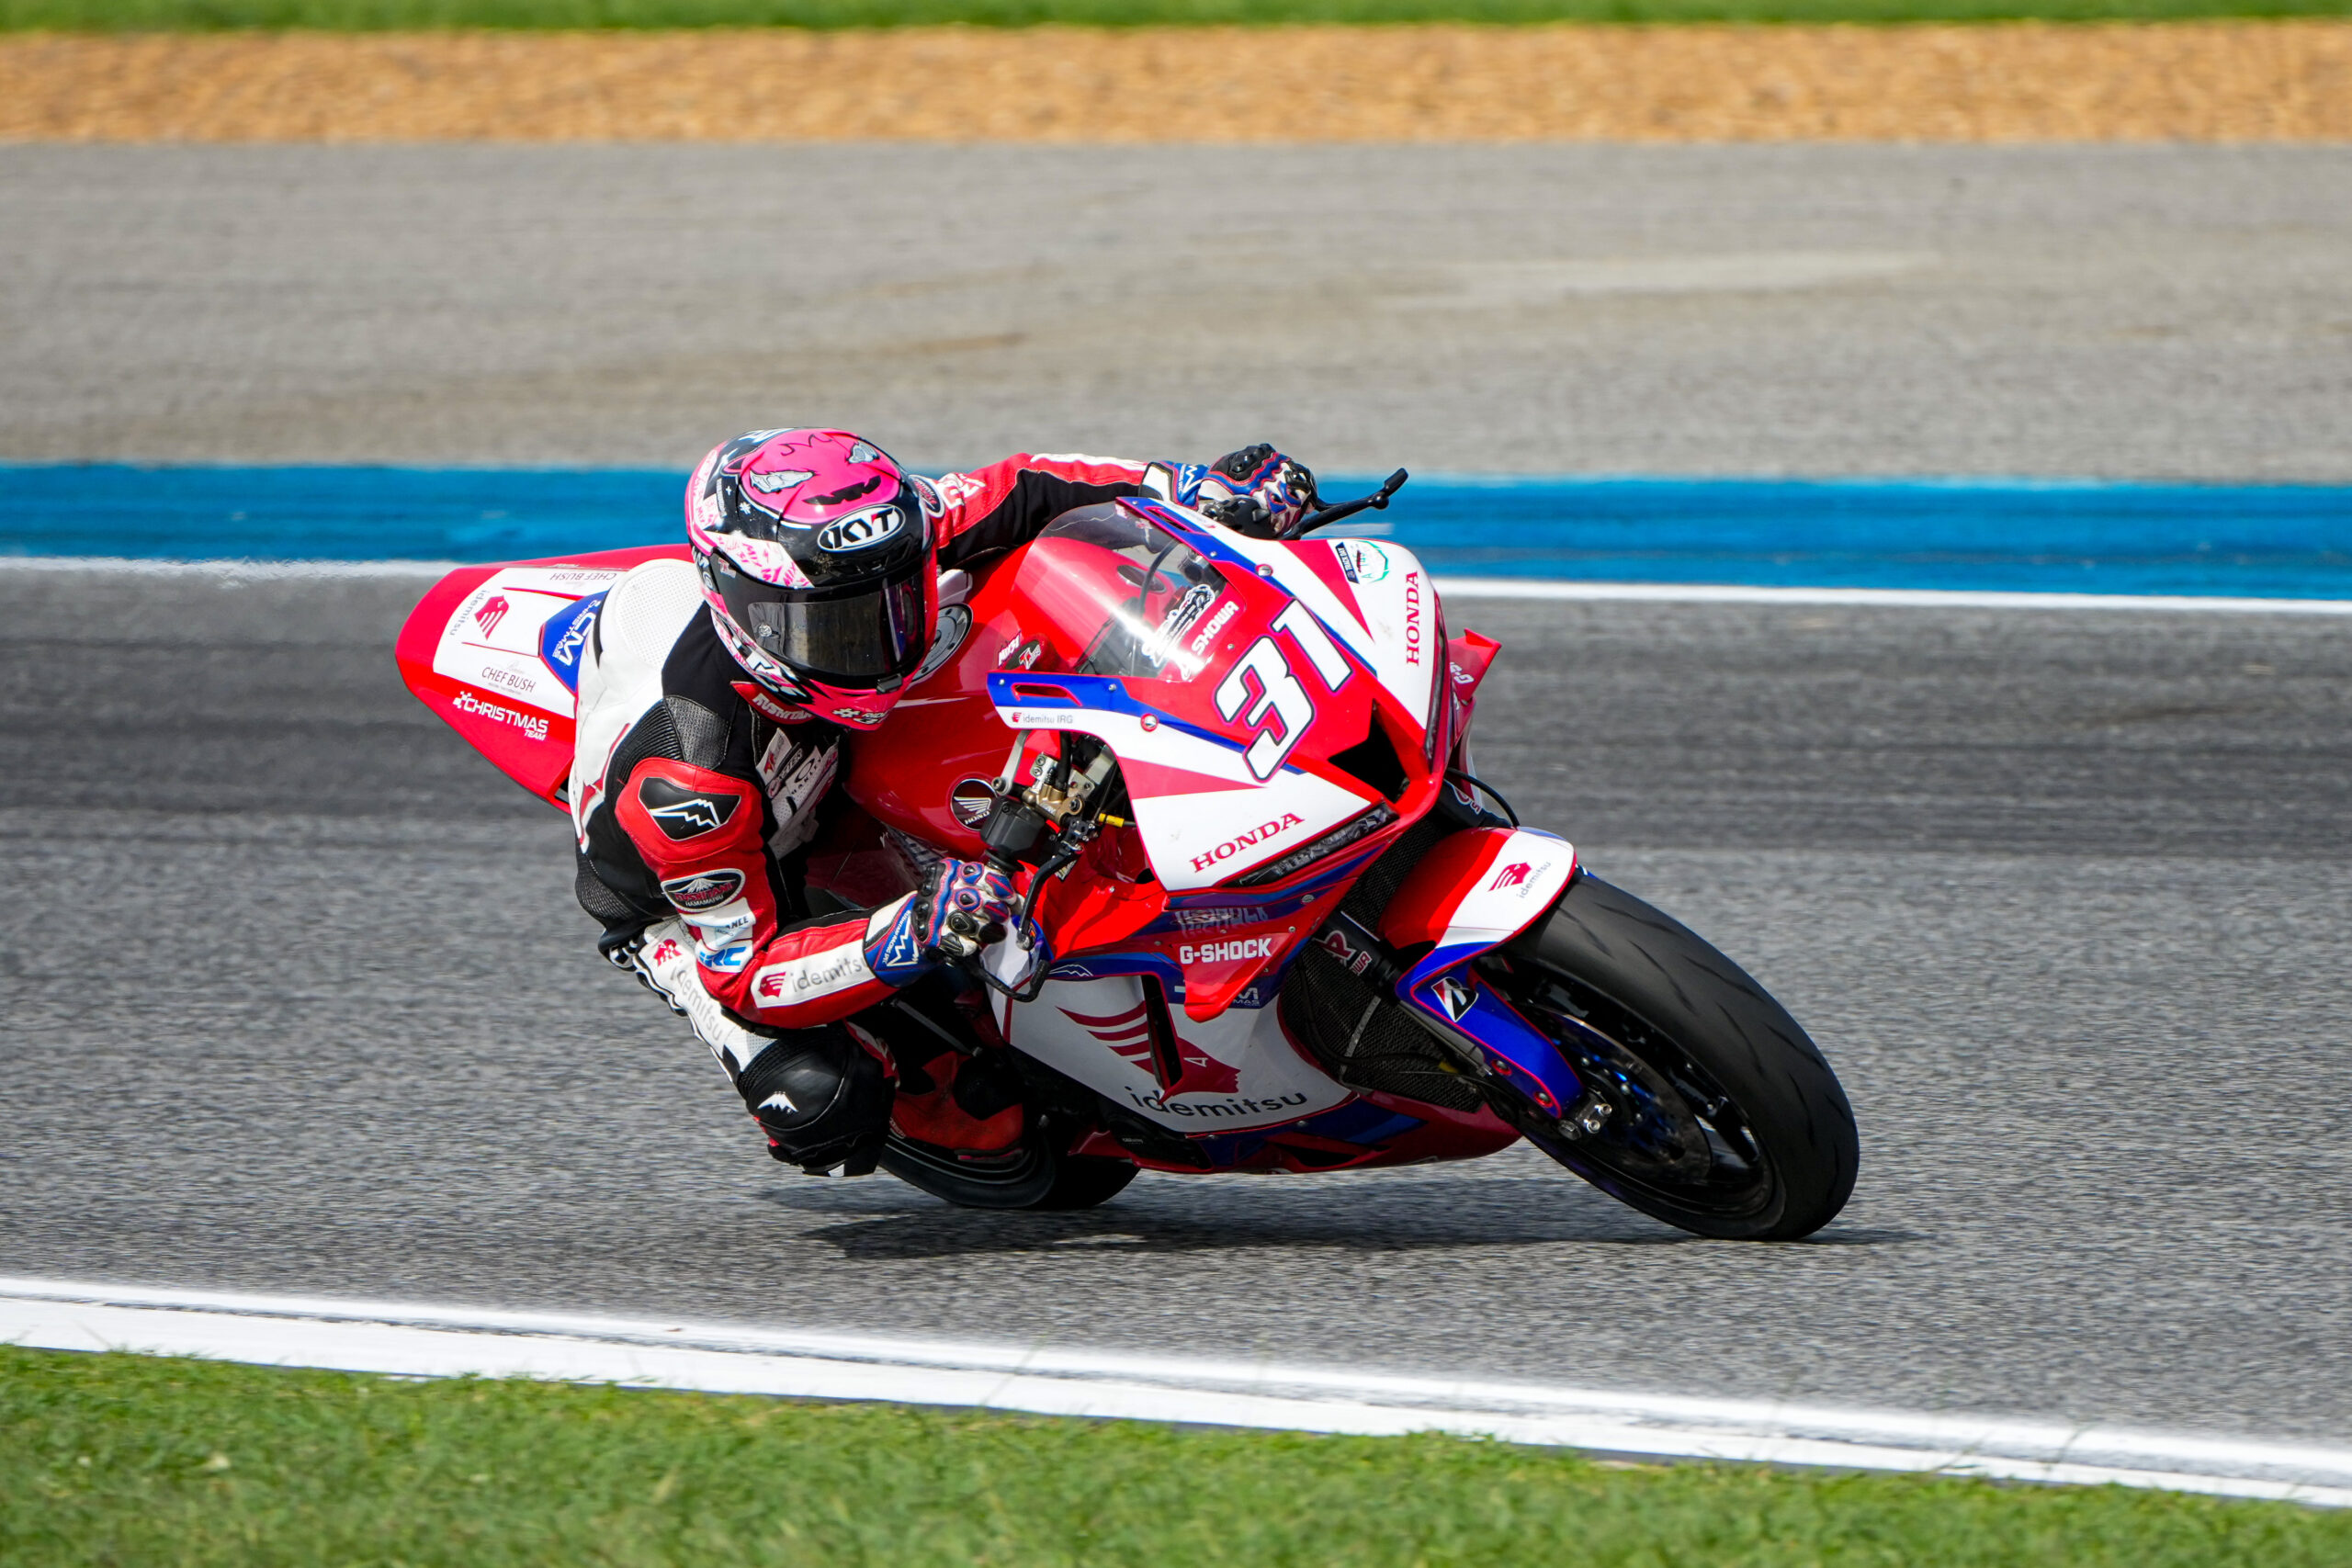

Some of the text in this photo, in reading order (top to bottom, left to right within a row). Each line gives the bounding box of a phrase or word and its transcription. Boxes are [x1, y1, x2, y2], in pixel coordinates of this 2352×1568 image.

[829, 509, 896, 549] KYT
[549, 572, 617, 581] CHEF BUSH
[449, 590, 490, 636] idemitsu
[1191, 601, 1239, 656] SHOWA
[1406, 570, 1419, 666] HONDA
[481, 667, 508, 682] CHEF
[507, 674, 537, 693] BUSH
[1213, 597, 1352, 783] 31
[462, 696, 549, 734] CHRISTMAS
[752, 693, 811, 720] KUSHITAN
[1023, 714, 1074, 725] idemitsu IRG
[525, 728, 547, 740] TEAM
[965, 808, 991, 825] HOND
[1190, 812, 1306, 873] HONDA
[675, 882, 733, 901] KUSHITANI
[1516, 862, 1552, 898] idemitsu
[685, 895, 724, 907] HAMAMATSU
[1180, 938, 1272, 964] G-SHOCK
[670, 966, 723, 1041] idemitsu
[1124, 1086, 1307, 1117] idemitsu
